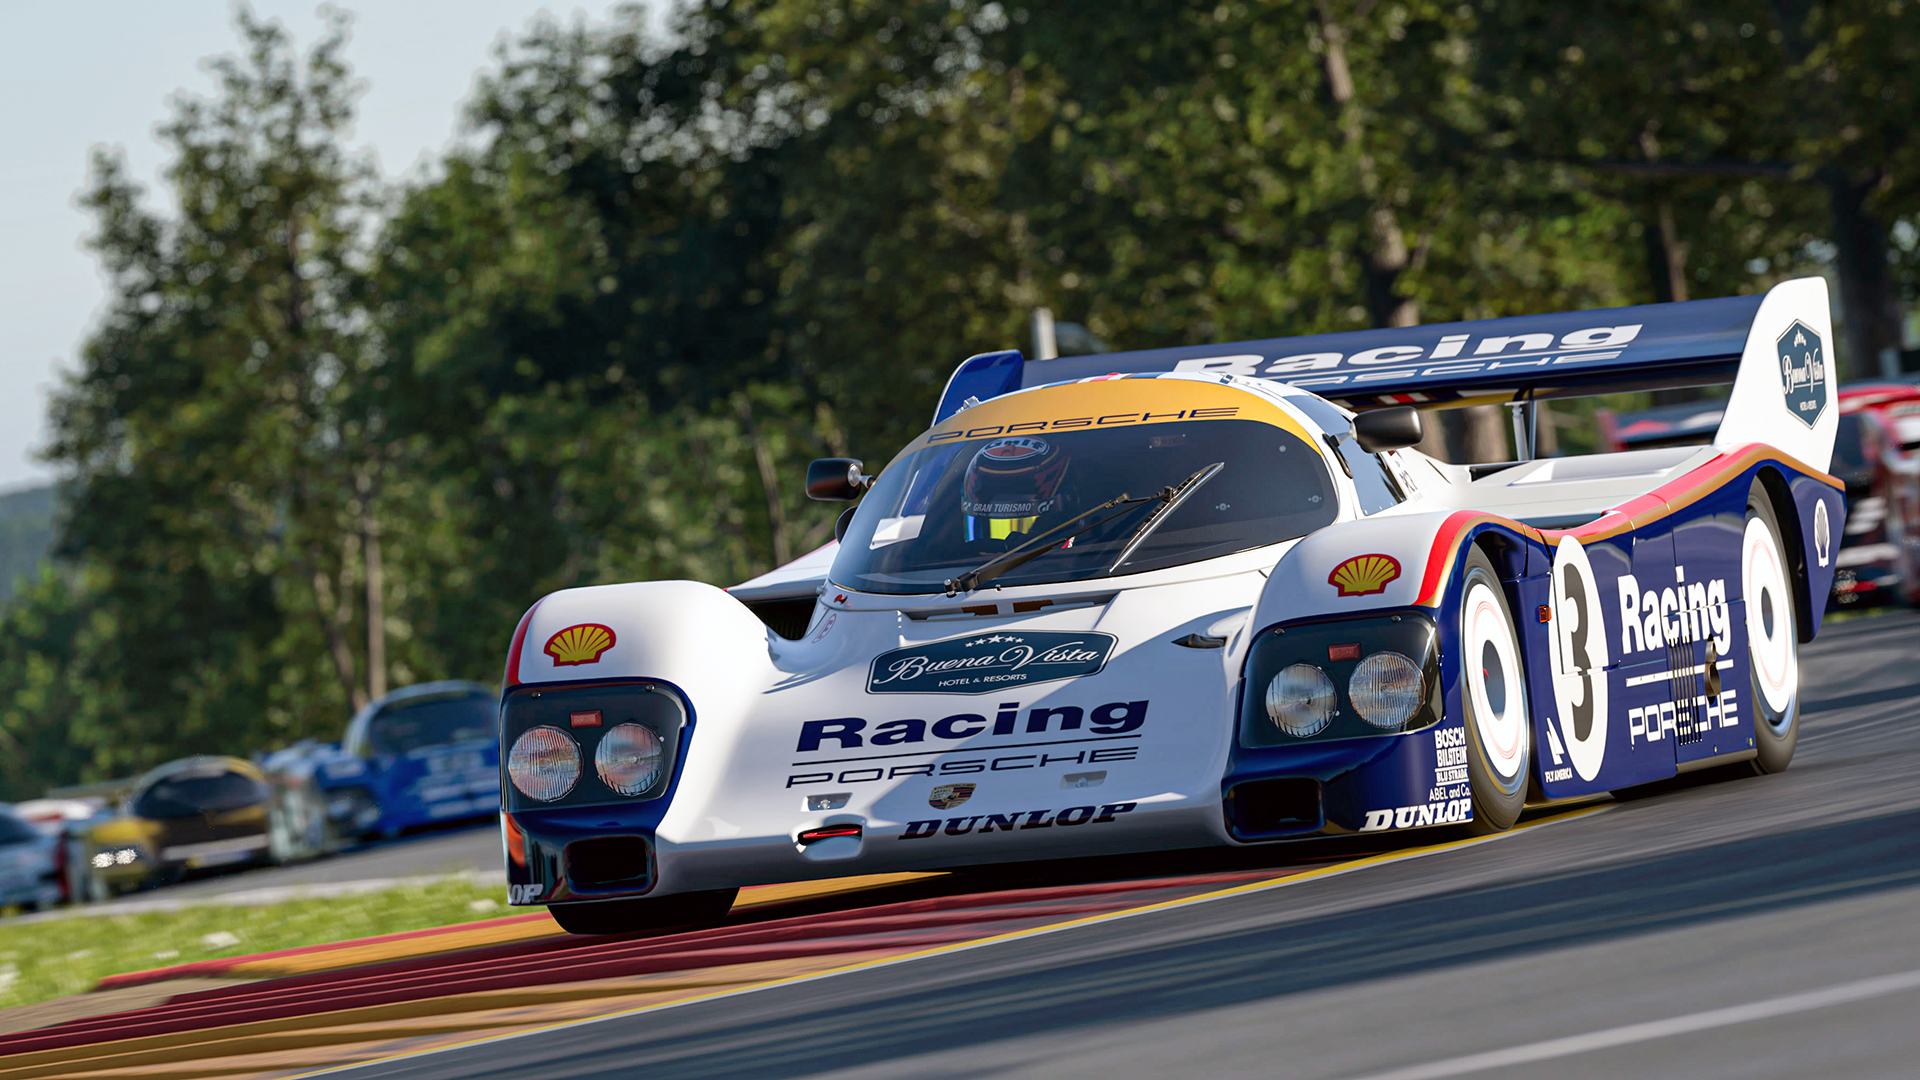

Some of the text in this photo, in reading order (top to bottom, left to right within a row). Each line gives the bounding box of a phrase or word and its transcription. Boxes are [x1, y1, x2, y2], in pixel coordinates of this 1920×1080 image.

[1173, 324, 1643, 376] Racing
[1284, 350, 1623, 387] RSCHE
[927, 407, 1240, 444] PORSCHE
[973, 503, 993, 513] GRAN
[994, 502, 1032, 513] TURISMO
[1617, 565, 1732, 656] Racing
[873, 641, 1100, 685] Buena Vista
[1563, 563, 1594, 742] 3
[938, 678, 970, 687] HOTEL
[983, 673, 1027, 683] RESORTS
[796, 700, 1150, 752] Racing
[1435, 727, 1466, 749] BOSCH
[785, 746, 1140, 789] PORSCHE
[1436, 745, 1468, 768] BILSTEIN
[1429, 786, 1449, 801] ABEL
[1449, 784, 1460, 799] and
[898, 802, 1138, 841] DUNLOP
[1359, 798, 1472, 833] DUNLOP
